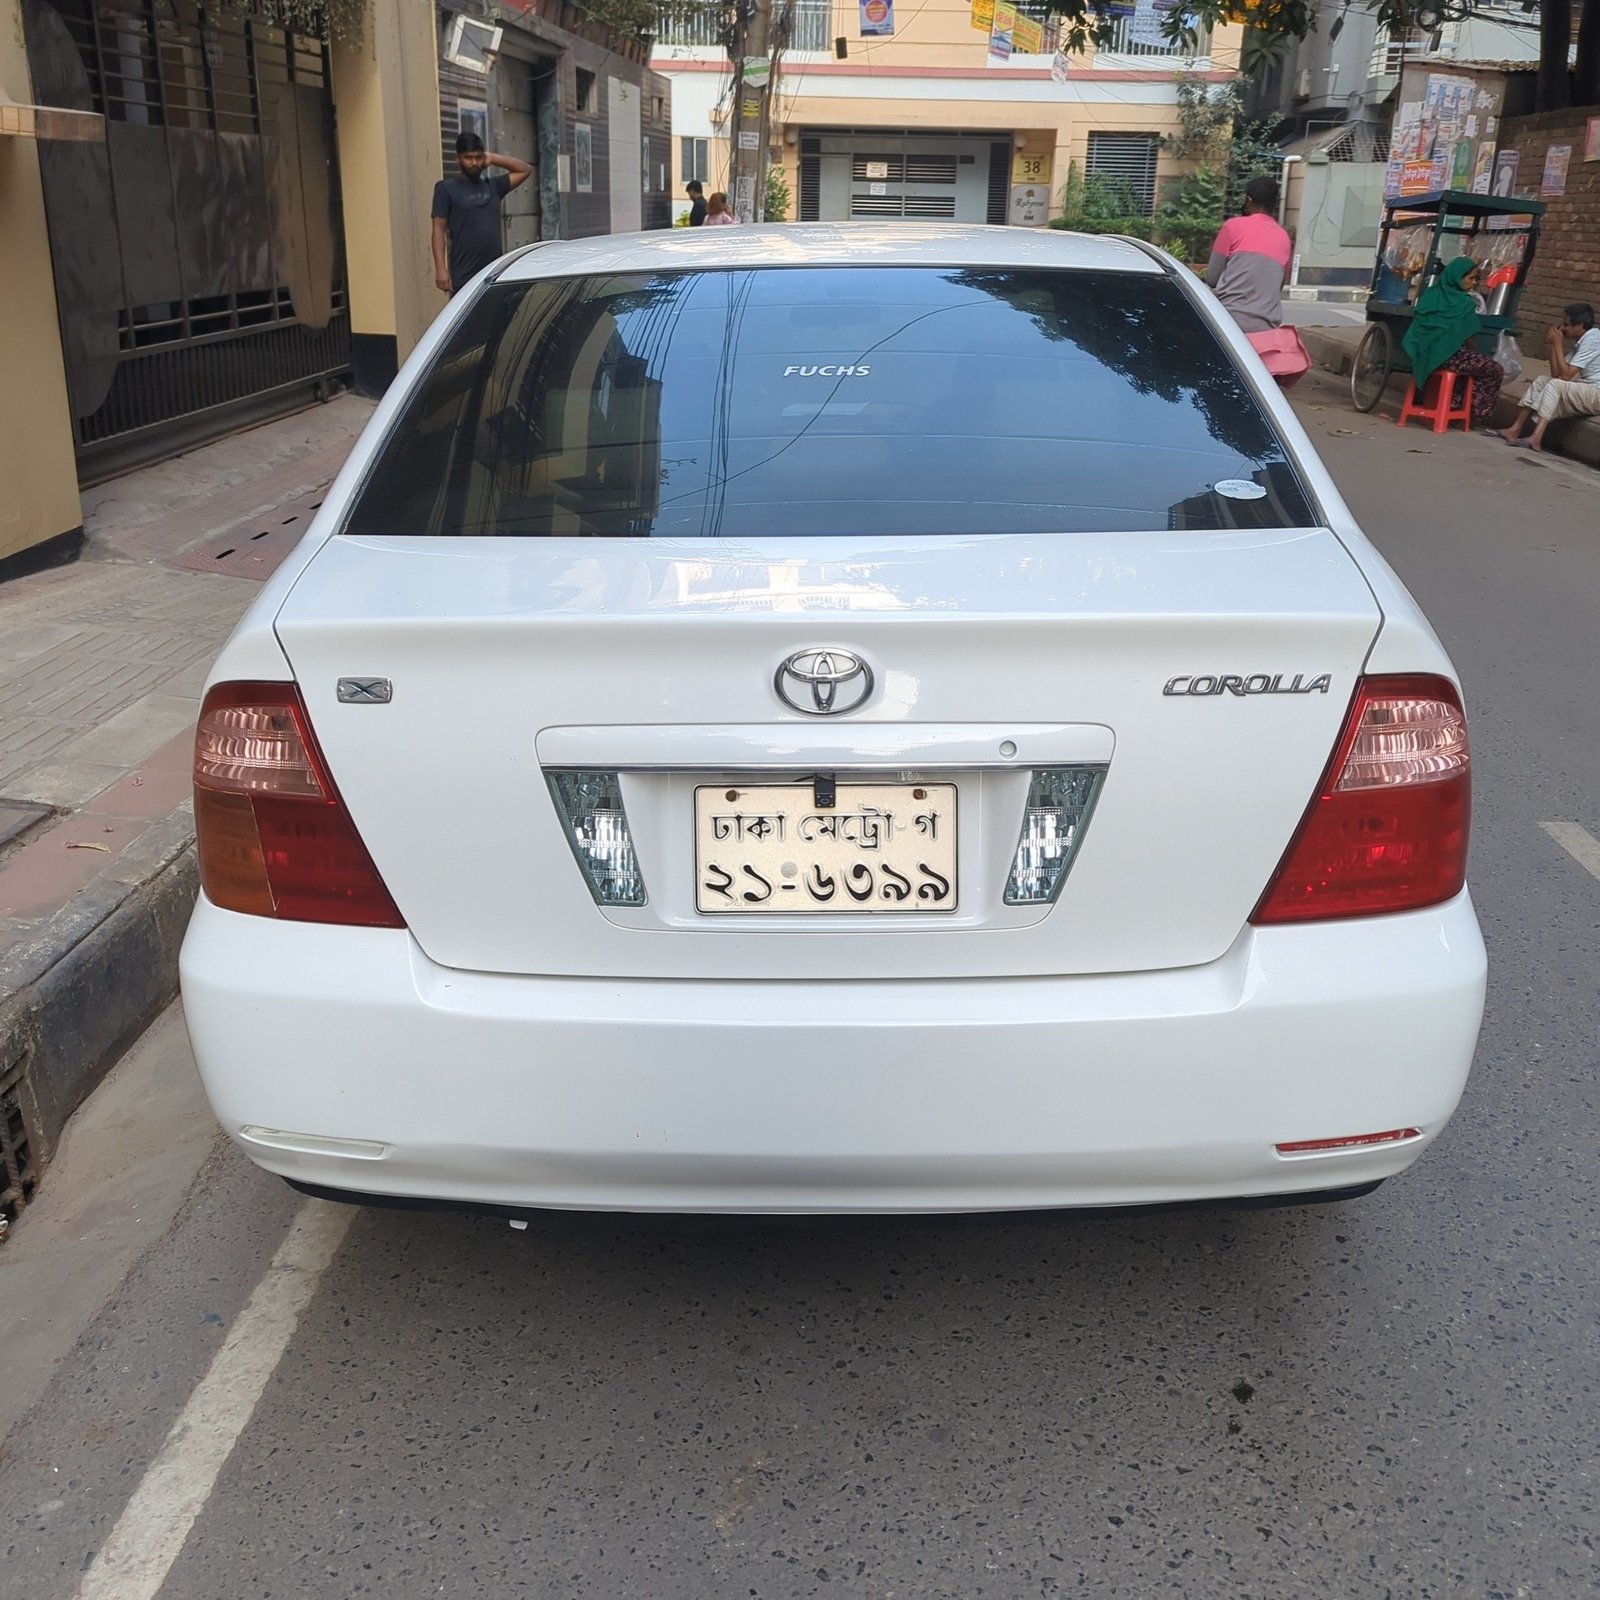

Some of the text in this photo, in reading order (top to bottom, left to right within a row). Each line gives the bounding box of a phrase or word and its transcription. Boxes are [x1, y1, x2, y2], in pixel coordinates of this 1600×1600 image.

[1023, 160, 1041, 174] 38
[783, 365, 870, 377] FUCHS
[1162, 673, 1332, 696] COROLLA
[711, 812, 786, 841] ঢাকা
[798, 803, 893, 850] মেট্রো
[704, 862, 950, 902] ২১-৬৩৯৯
